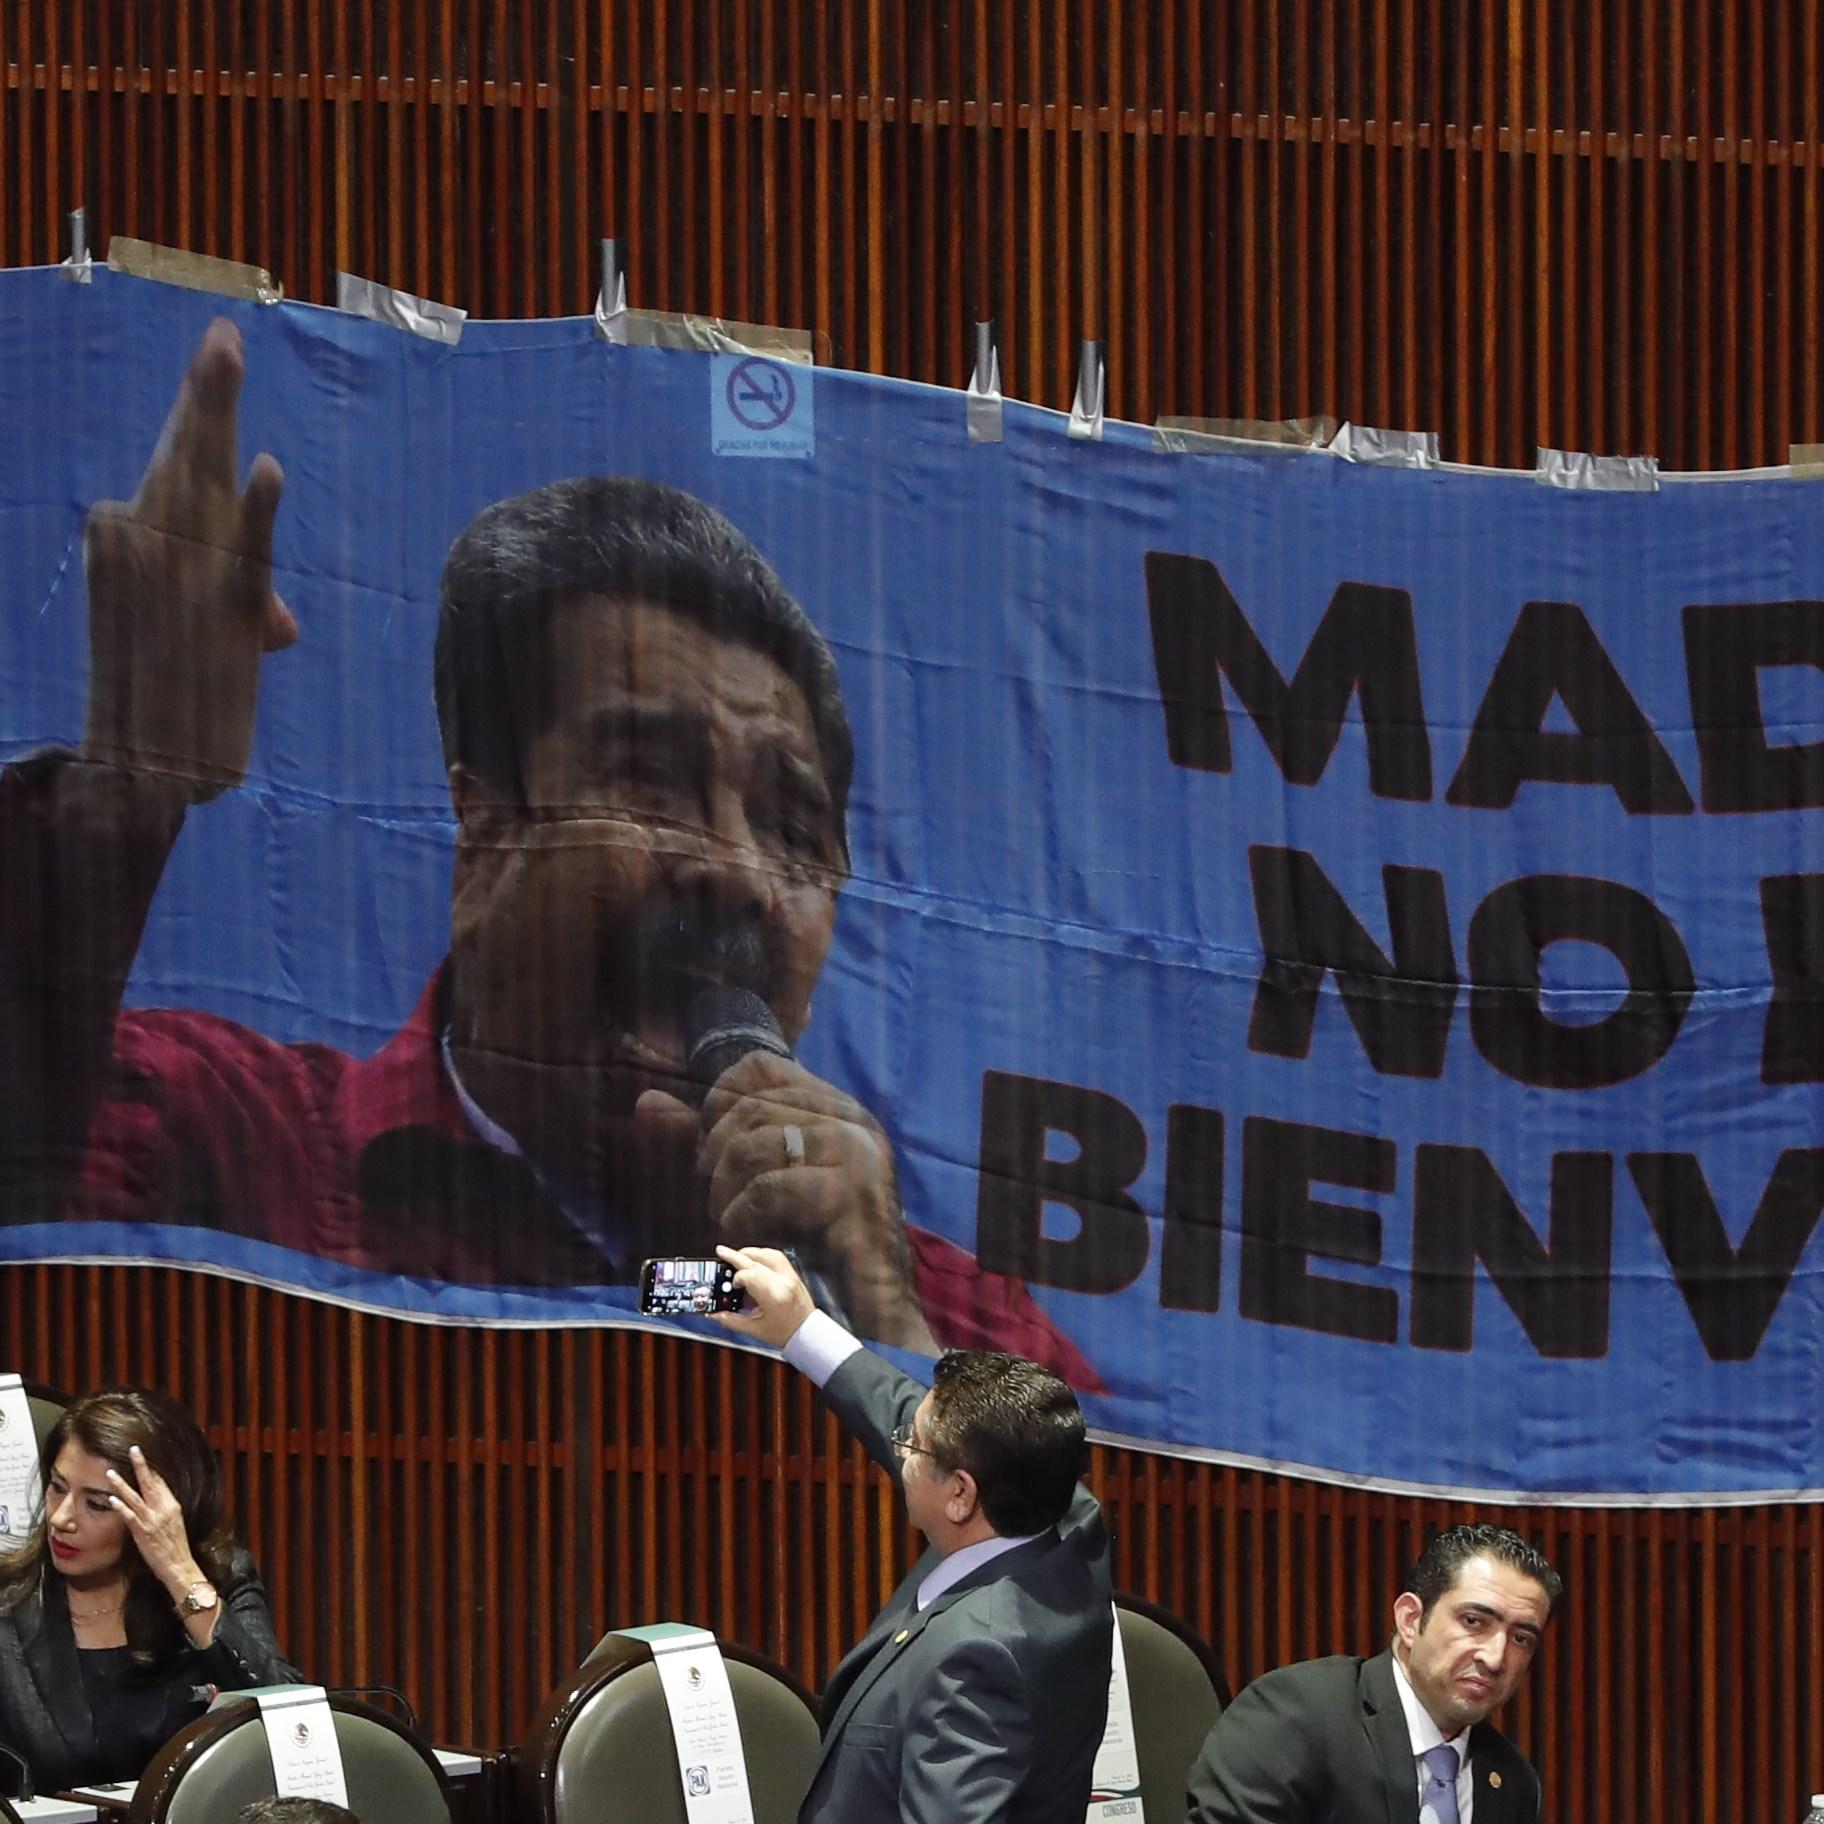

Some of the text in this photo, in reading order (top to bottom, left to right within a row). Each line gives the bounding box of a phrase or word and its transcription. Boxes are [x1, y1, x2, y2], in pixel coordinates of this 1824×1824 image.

[1248, 844, 1694, 1089] NO
[693, 1774, 706, 1787] PAN
[1102, 1801, 1136, 1818] CONGRESO
